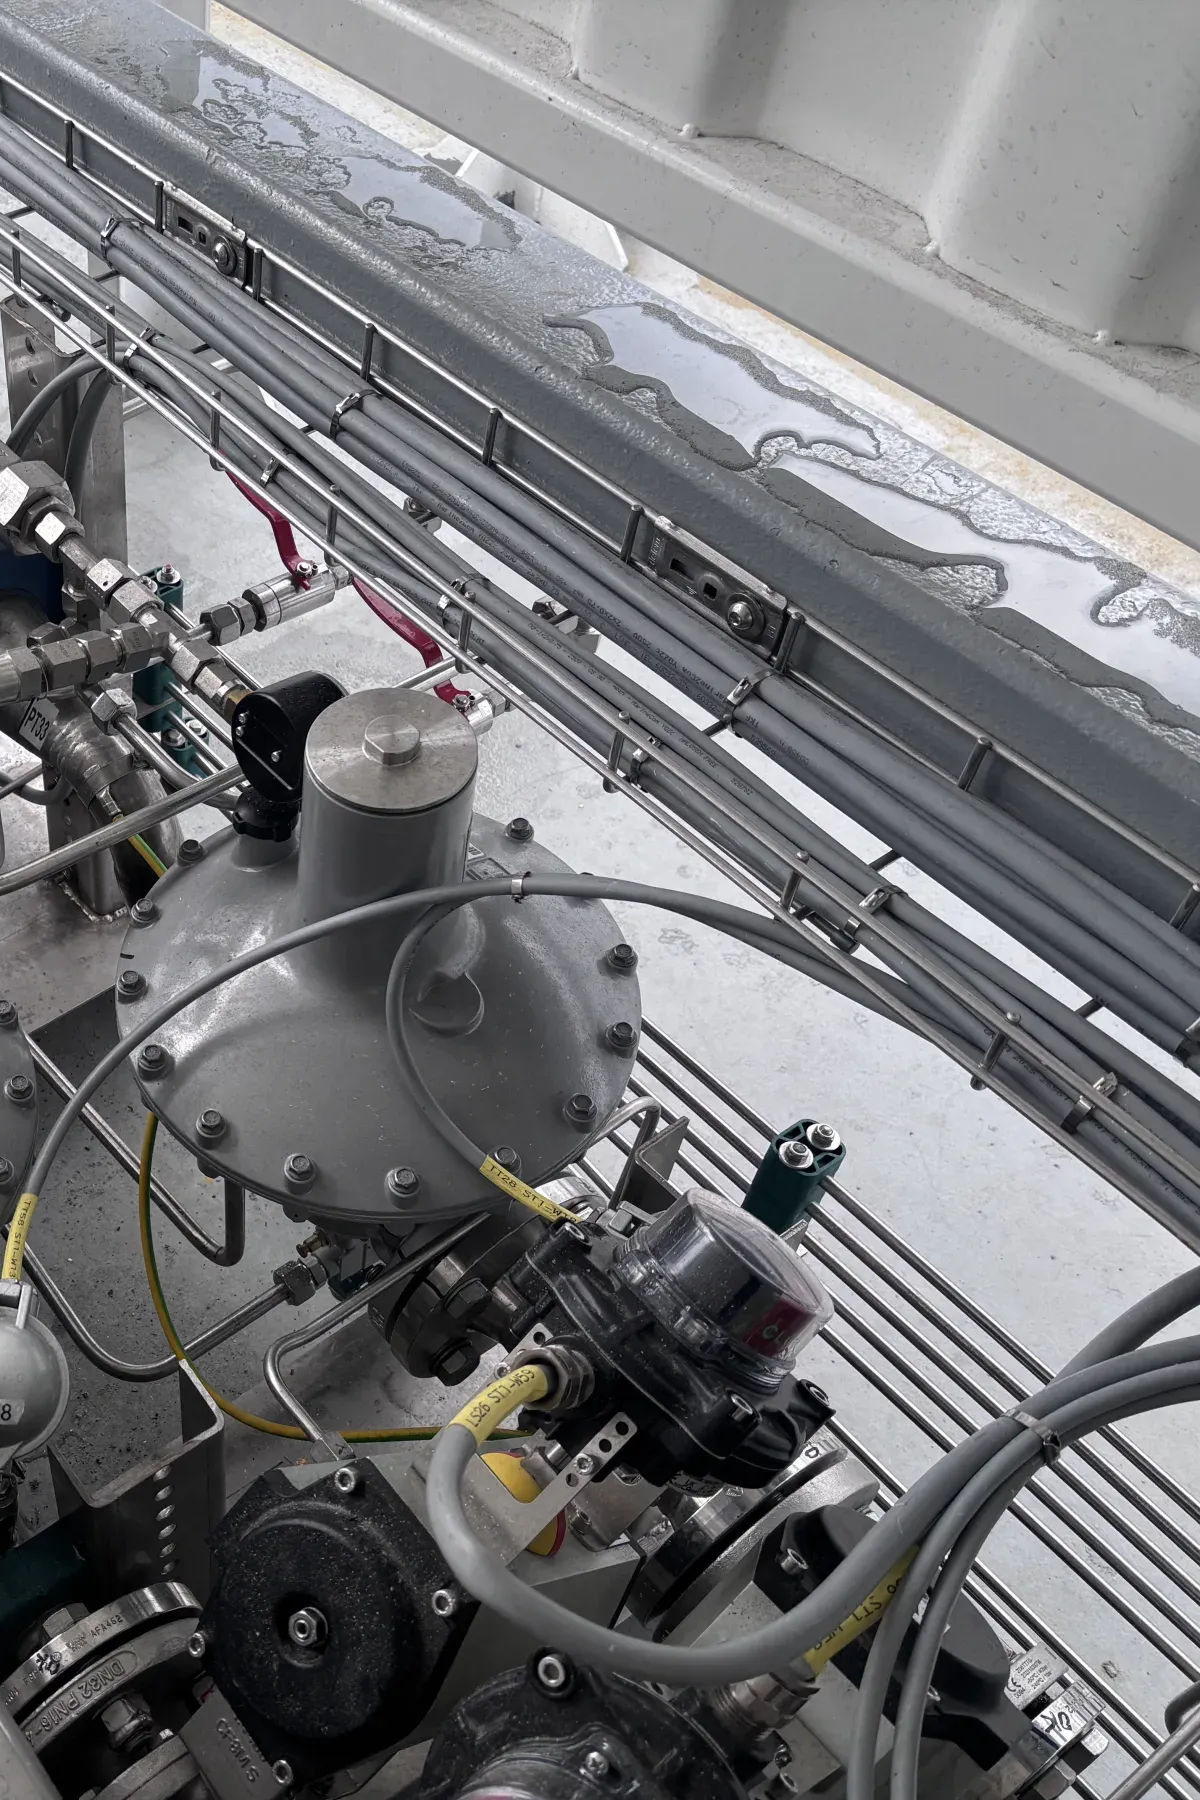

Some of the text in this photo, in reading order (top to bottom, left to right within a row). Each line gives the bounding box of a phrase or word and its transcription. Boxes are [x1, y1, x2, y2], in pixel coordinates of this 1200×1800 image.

[23, 707, 50, 741] PT33
[489, 1163, 517, 1188] TT28
[9, 1200, 32, 1279] TT58 ST1-W13
[466, 1369, 536, 1428] LS26 ST1-W59
[90, 1614, 124, 1638] AFA462
[78, 1659, 125, 1699] DN32
